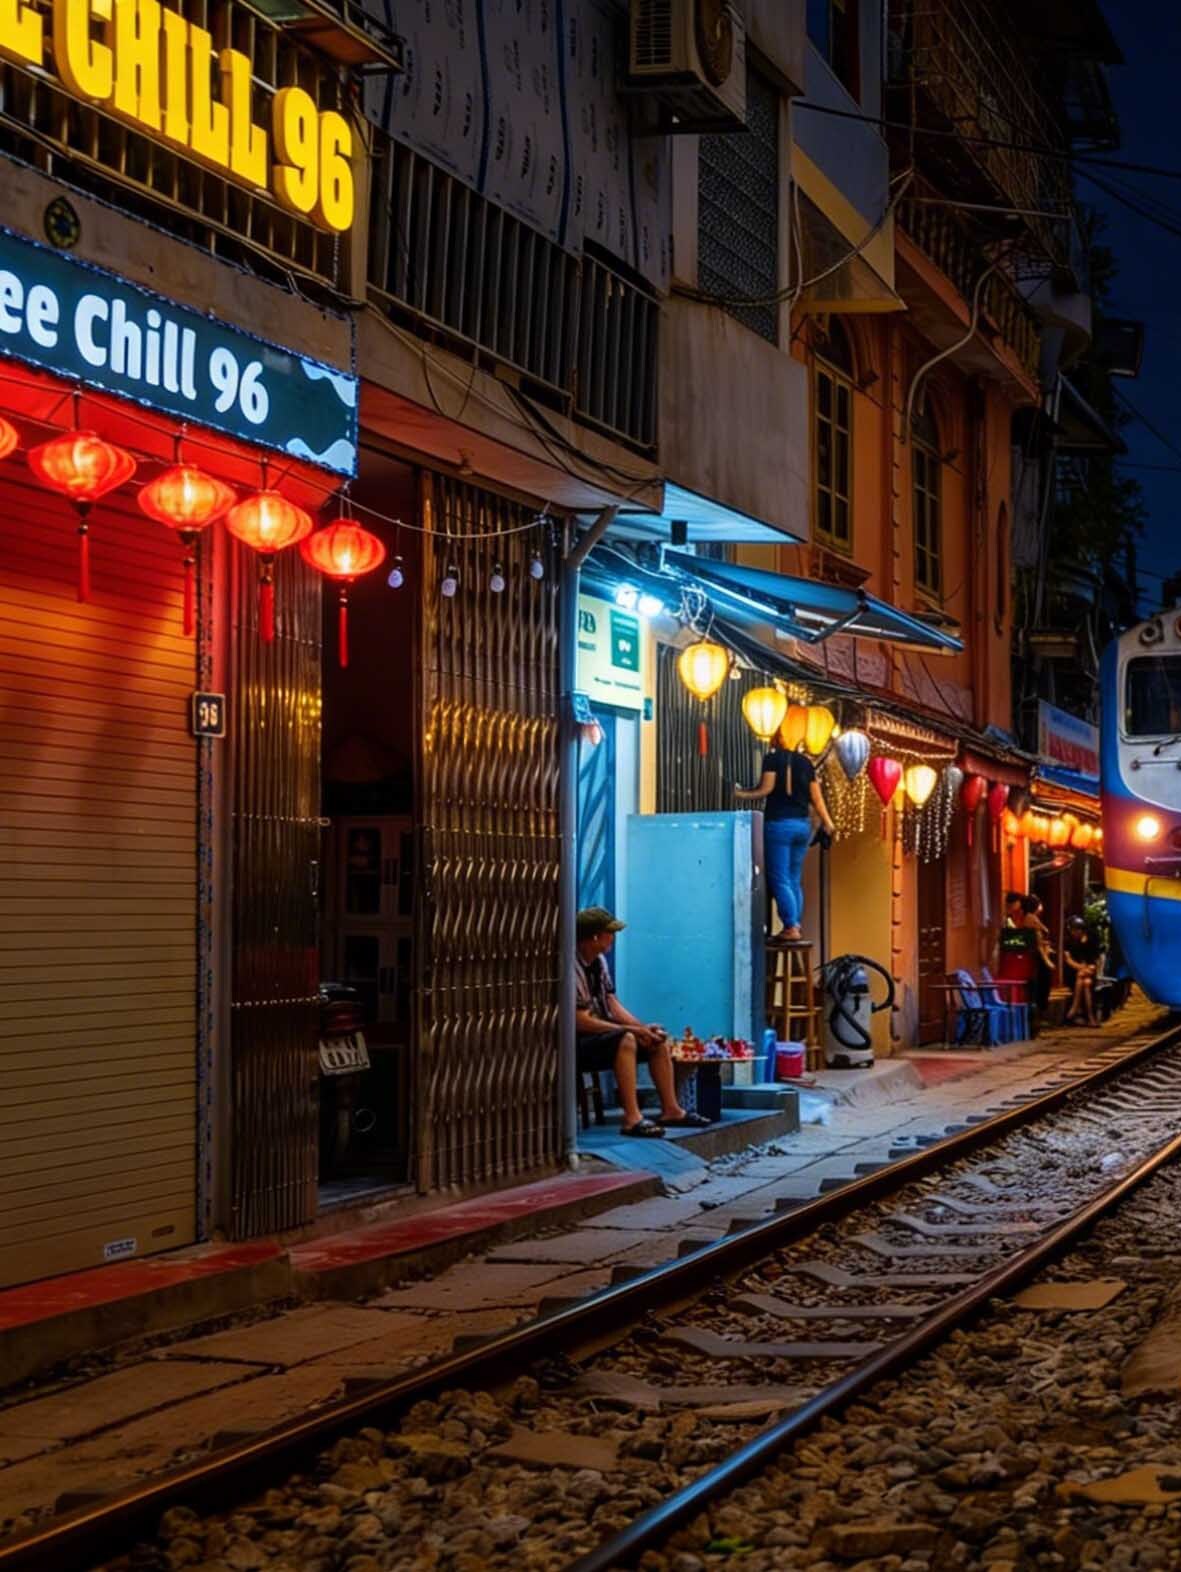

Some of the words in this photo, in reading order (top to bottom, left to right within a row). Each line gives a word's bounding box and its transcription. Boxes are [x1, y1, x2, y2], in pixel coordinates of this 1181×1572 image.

[56, 0, 267, 189] CHILL
[274, 86, 354, 231] 96
[0, 270, 59, 348] ee
[74, 294, 197, 400] Chill
[209, 347, 269, 424] 96
